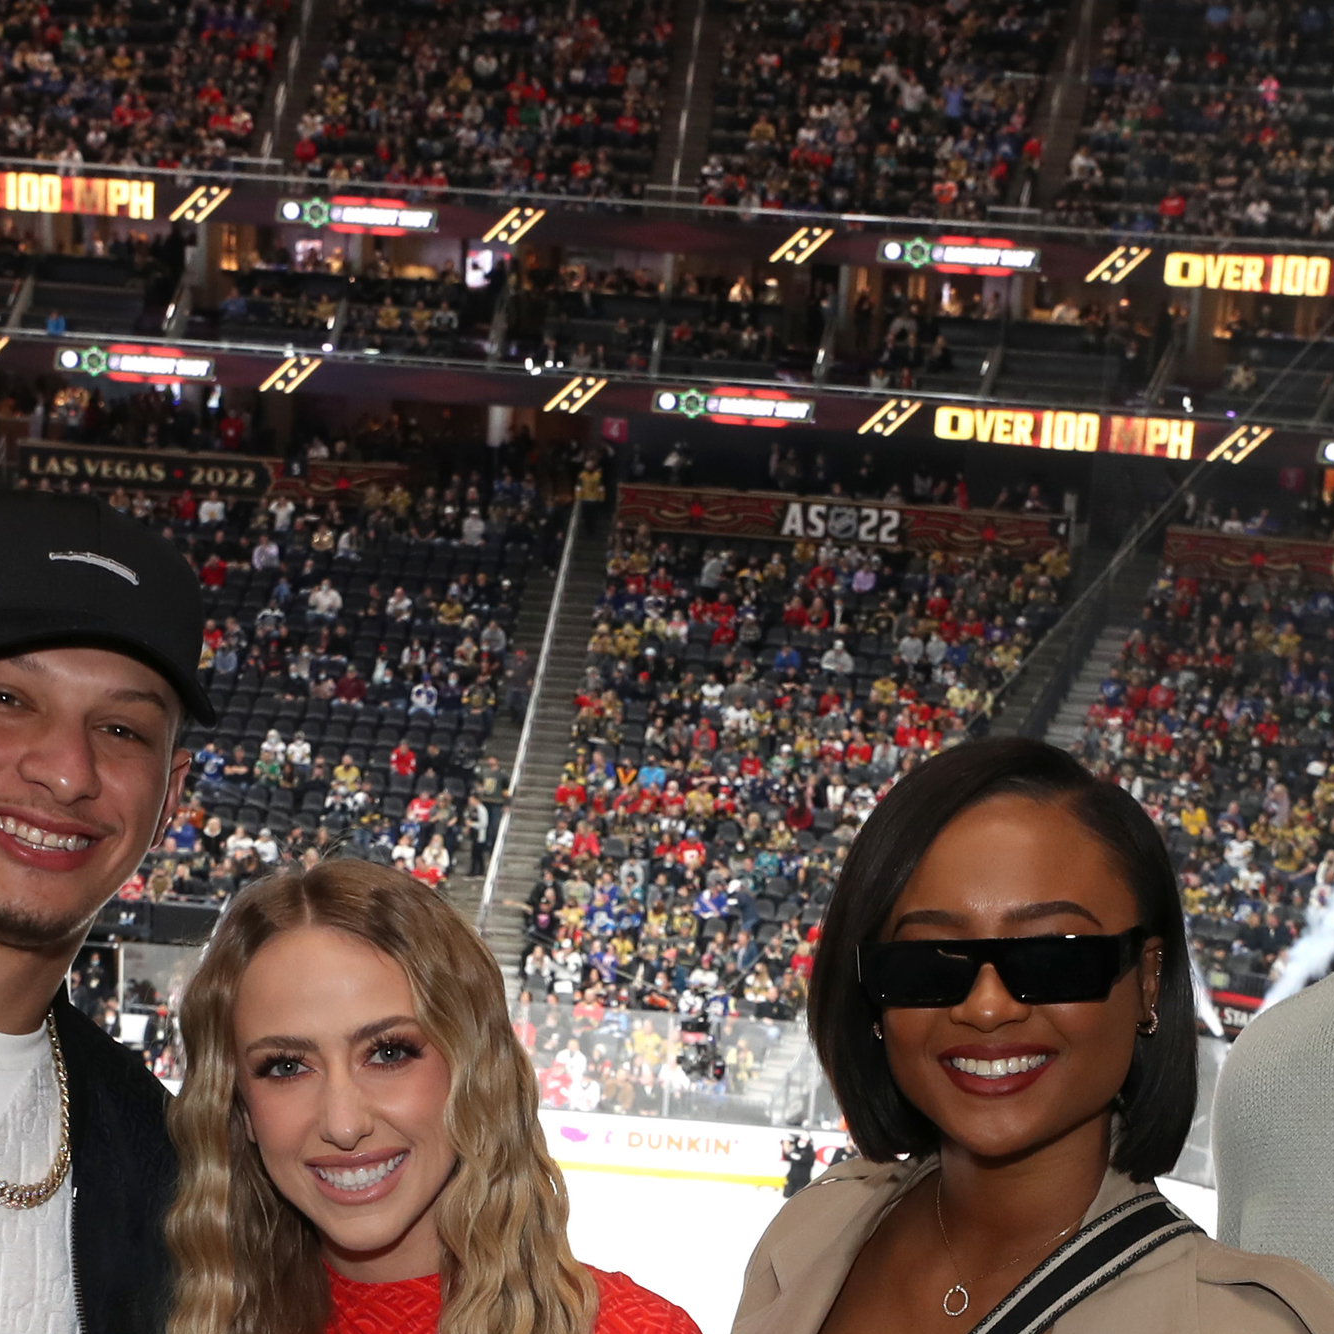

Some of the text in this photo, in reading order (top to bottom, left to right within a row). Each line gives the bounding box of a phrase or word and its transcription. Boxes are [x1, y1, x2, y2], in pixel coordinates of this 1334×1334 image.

[4, 171, 63, 213] 100
[74, 177, 155, 220] MPH
[1164, 252, 1266, 293] OVER
[1269, 256, 1330, 296] 100
[935, 405, 1195, 460] OVER 100 MPH
[29, 455, 256, 488] LAS VEGAS 2022
[780, 502, 901, 544] AS 22
[627, 1130, 739, 1156] DUNKIN'
